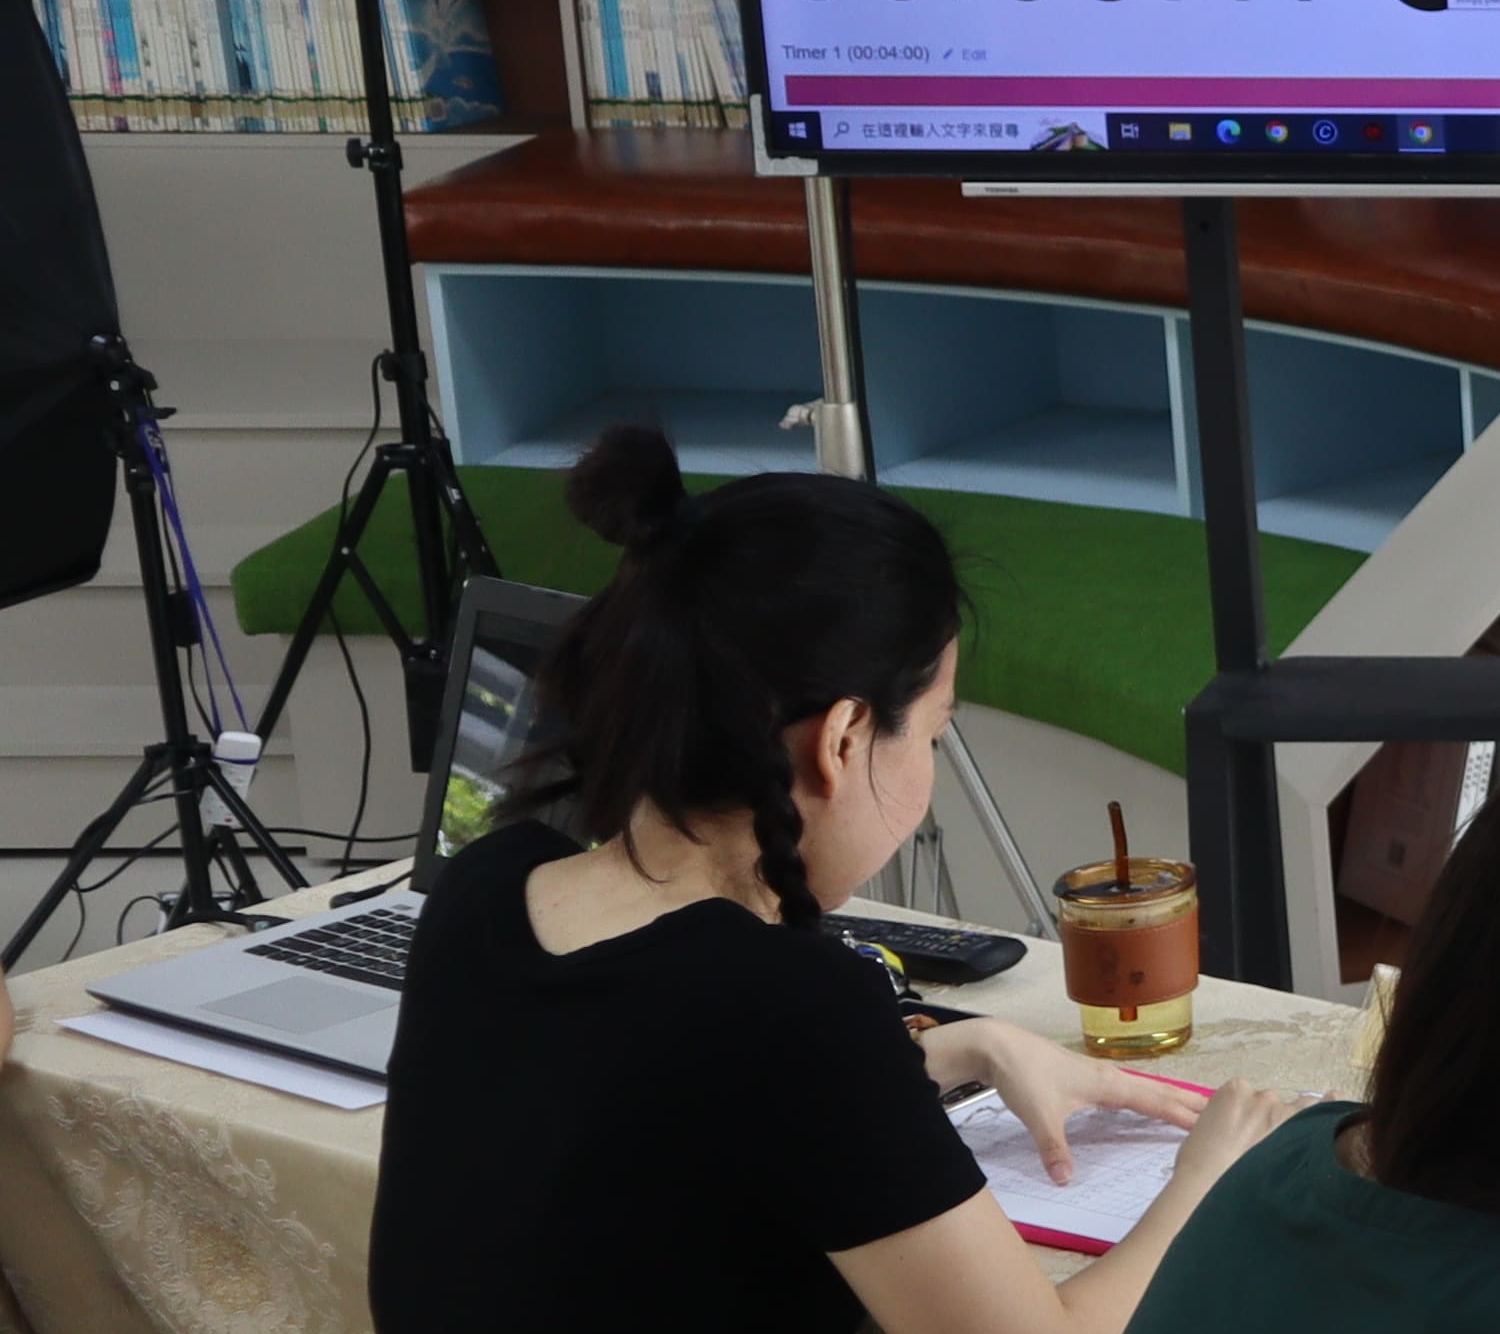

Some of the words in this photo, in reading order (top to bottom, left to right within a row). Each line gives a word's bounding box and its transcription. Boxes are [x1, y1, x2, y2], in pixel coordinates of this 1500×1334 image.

[782, 44, 827, 60] Timer
[847, 44, 931, 63] (00:04:00)
[962, 47, 987, 61] Edit
